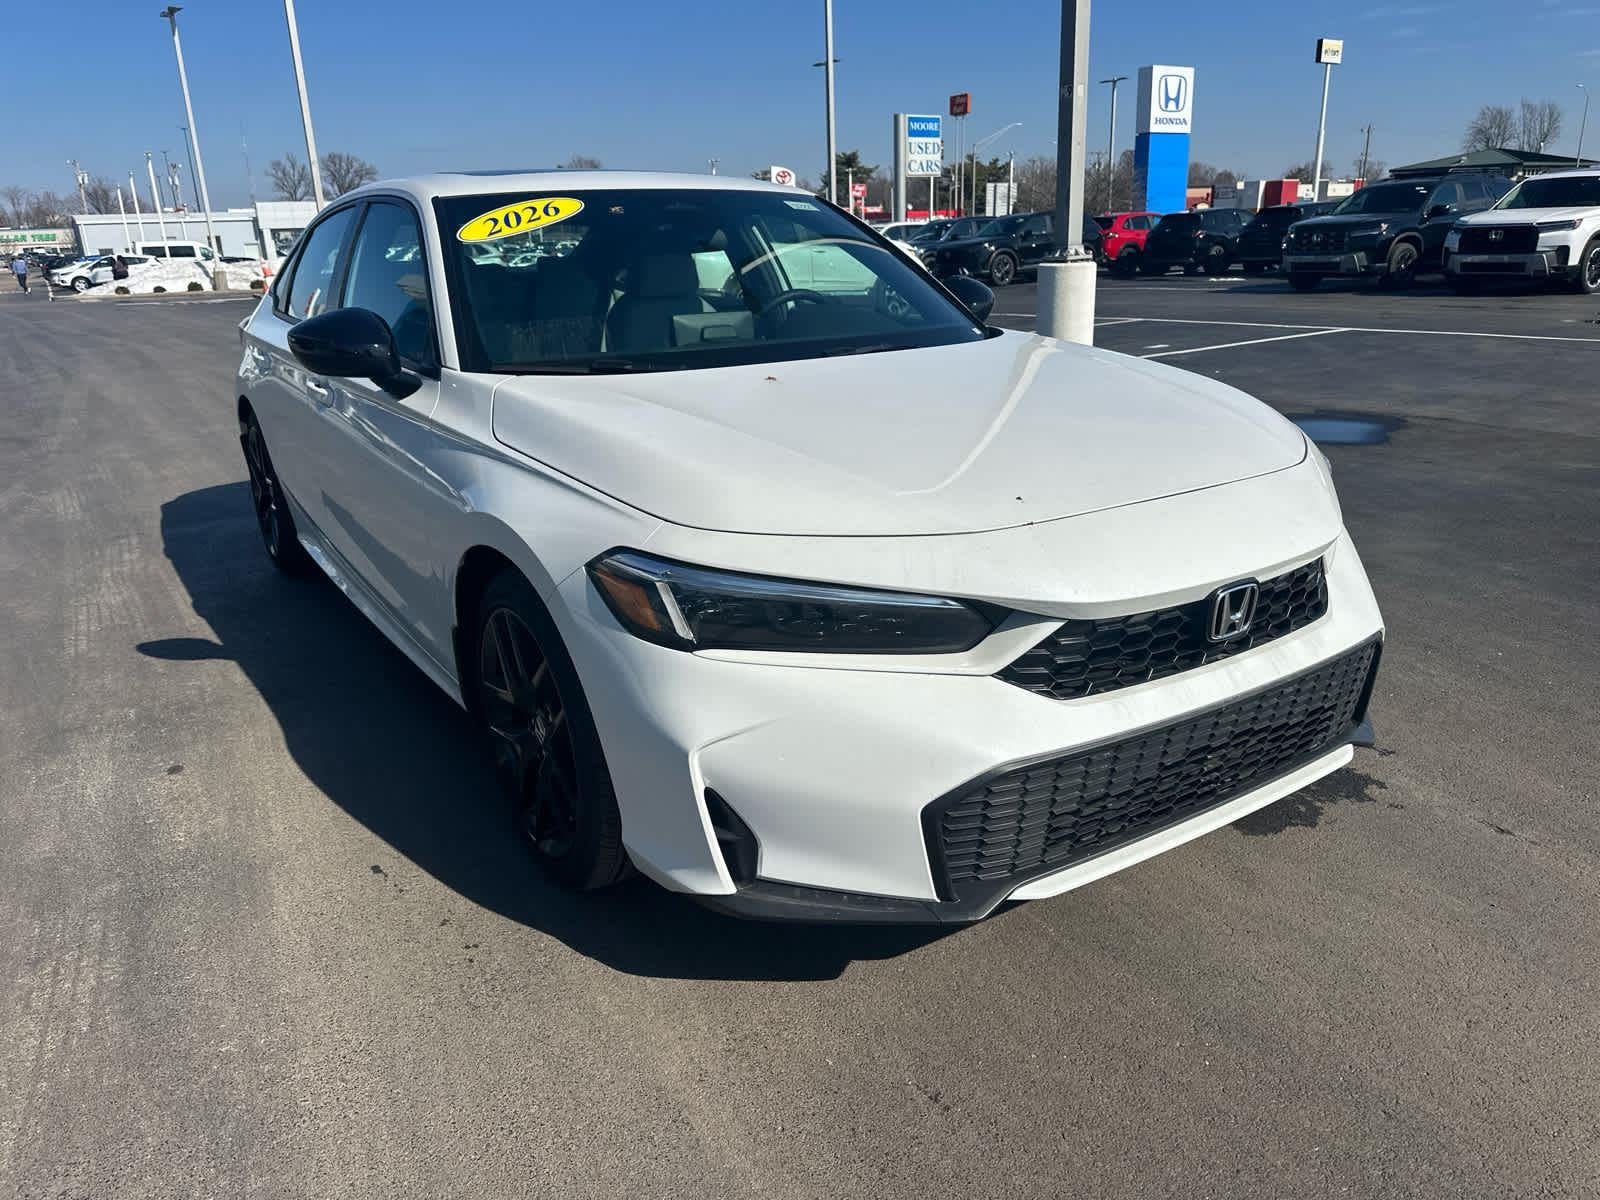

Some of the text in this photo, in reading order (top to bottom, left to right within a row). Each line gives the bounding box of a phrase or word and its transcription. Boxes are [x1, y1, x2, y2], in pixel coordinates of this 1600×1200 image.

[909, 121, 939, 131] MOORE
[1154, 117, 1188, 126] HONDA
[908, 142, 941, 155] USED
[907, 160, 941, 172] CARS
[482, 200, 560, 237] 2026
